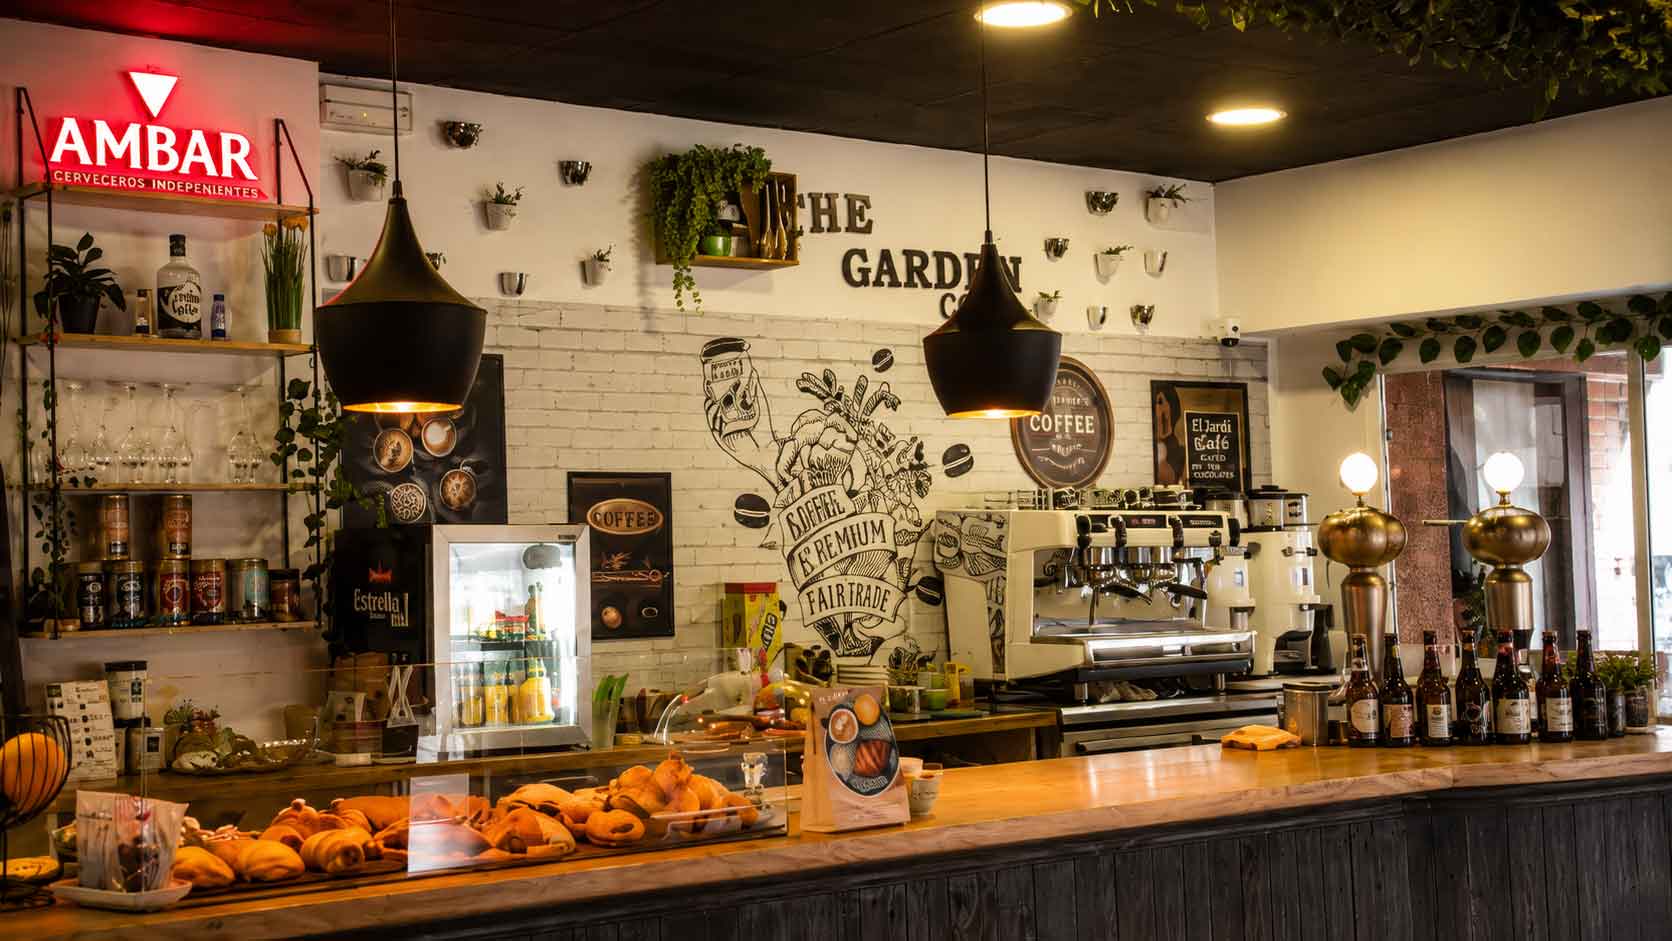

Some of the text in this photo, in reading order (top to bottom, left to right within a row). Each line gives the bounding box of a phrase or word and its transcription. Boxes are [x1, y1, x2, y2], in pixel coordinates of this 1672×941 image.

[50, 117, 257, 180] AMBAR
[54, 170, 145, 188] CERVECEROS
[1029, 414, 1095, 434] COFFEE
[593, 511, 657, 528] COFFEE
[354, 588, 399, 613] Estrella
